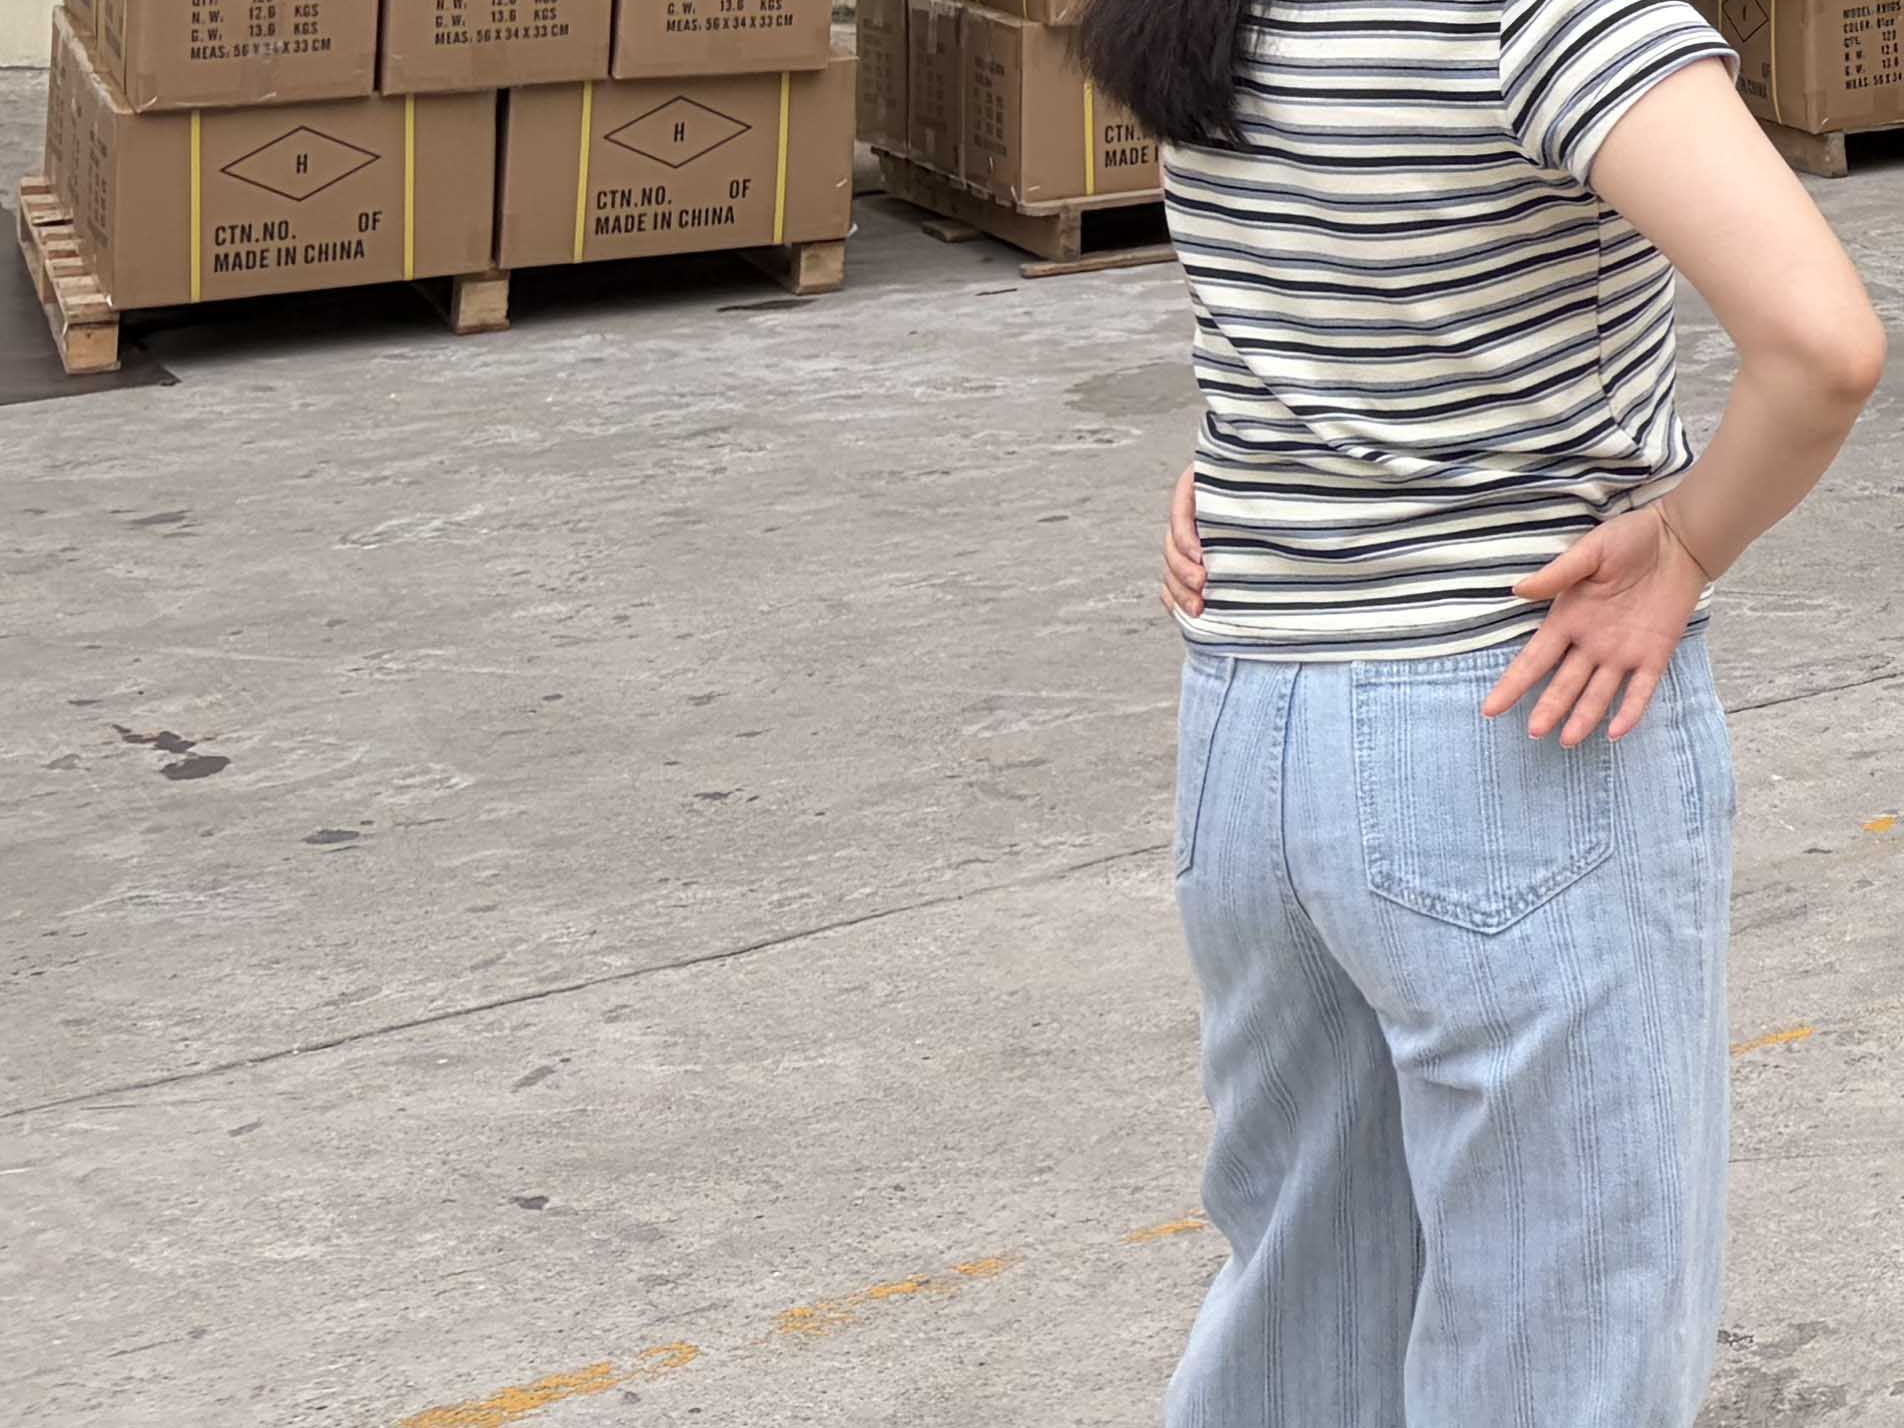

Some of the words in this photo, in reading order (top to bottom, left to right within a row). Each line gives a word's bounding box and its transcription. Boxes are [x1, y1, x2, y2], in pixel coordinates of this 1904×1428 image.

[674, 122, 684, 142] H
[296, 154, 307, 174] H
[597, 186, 672, 210] CTN.NO.
[729, 179, 751, 199] OF
[214, 222, 296, 246] CTN.NO.
[358, 211, 382, 232] OF
[595, 213, 647, 235] MADE
[653, 211, 672, 230] IN
[679, 206, 734, 228] CHINA
[214, 248, 269, 272] MADE
[277, 246, 296, 267] IN
[304, 240, 364, 264] CHINA
